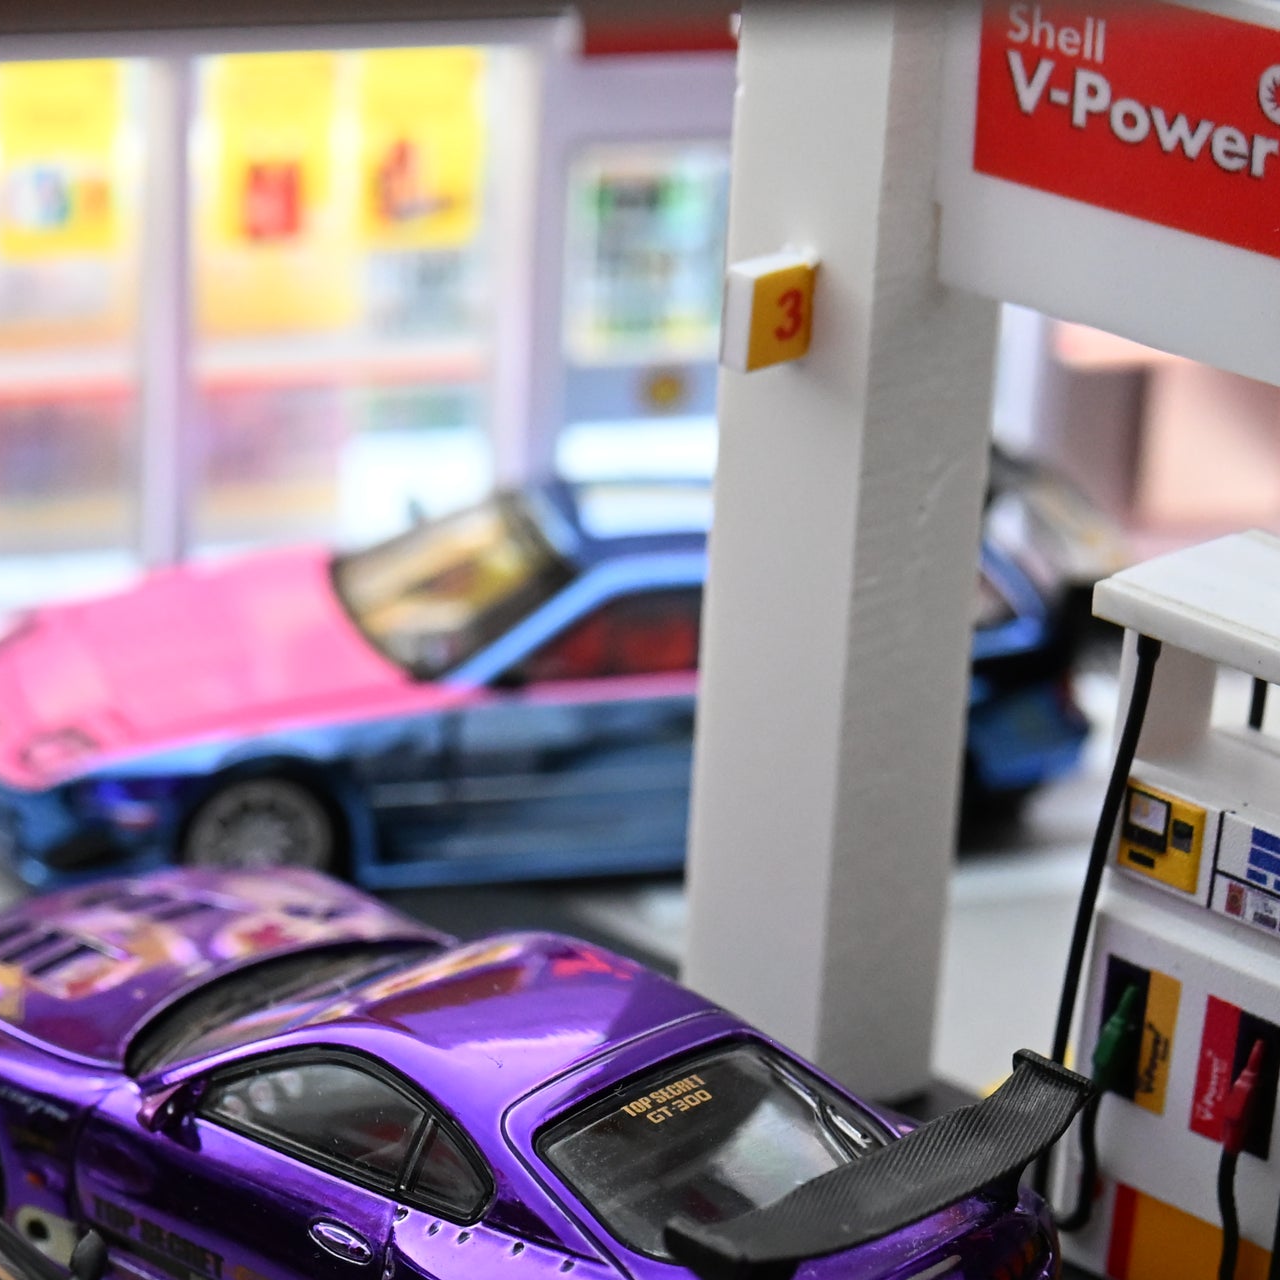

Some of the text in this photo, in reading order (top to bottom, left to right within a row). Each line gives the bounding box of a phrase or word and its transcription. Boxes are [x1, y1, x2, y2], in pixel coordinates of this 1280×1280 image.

[1007, 0, 1107, 64] Shell
[1007, 49, 1280, 179] V-Power
[775, 287, 803, 342] 3
[622, 1074, 707, 1117] TOP SECRET
